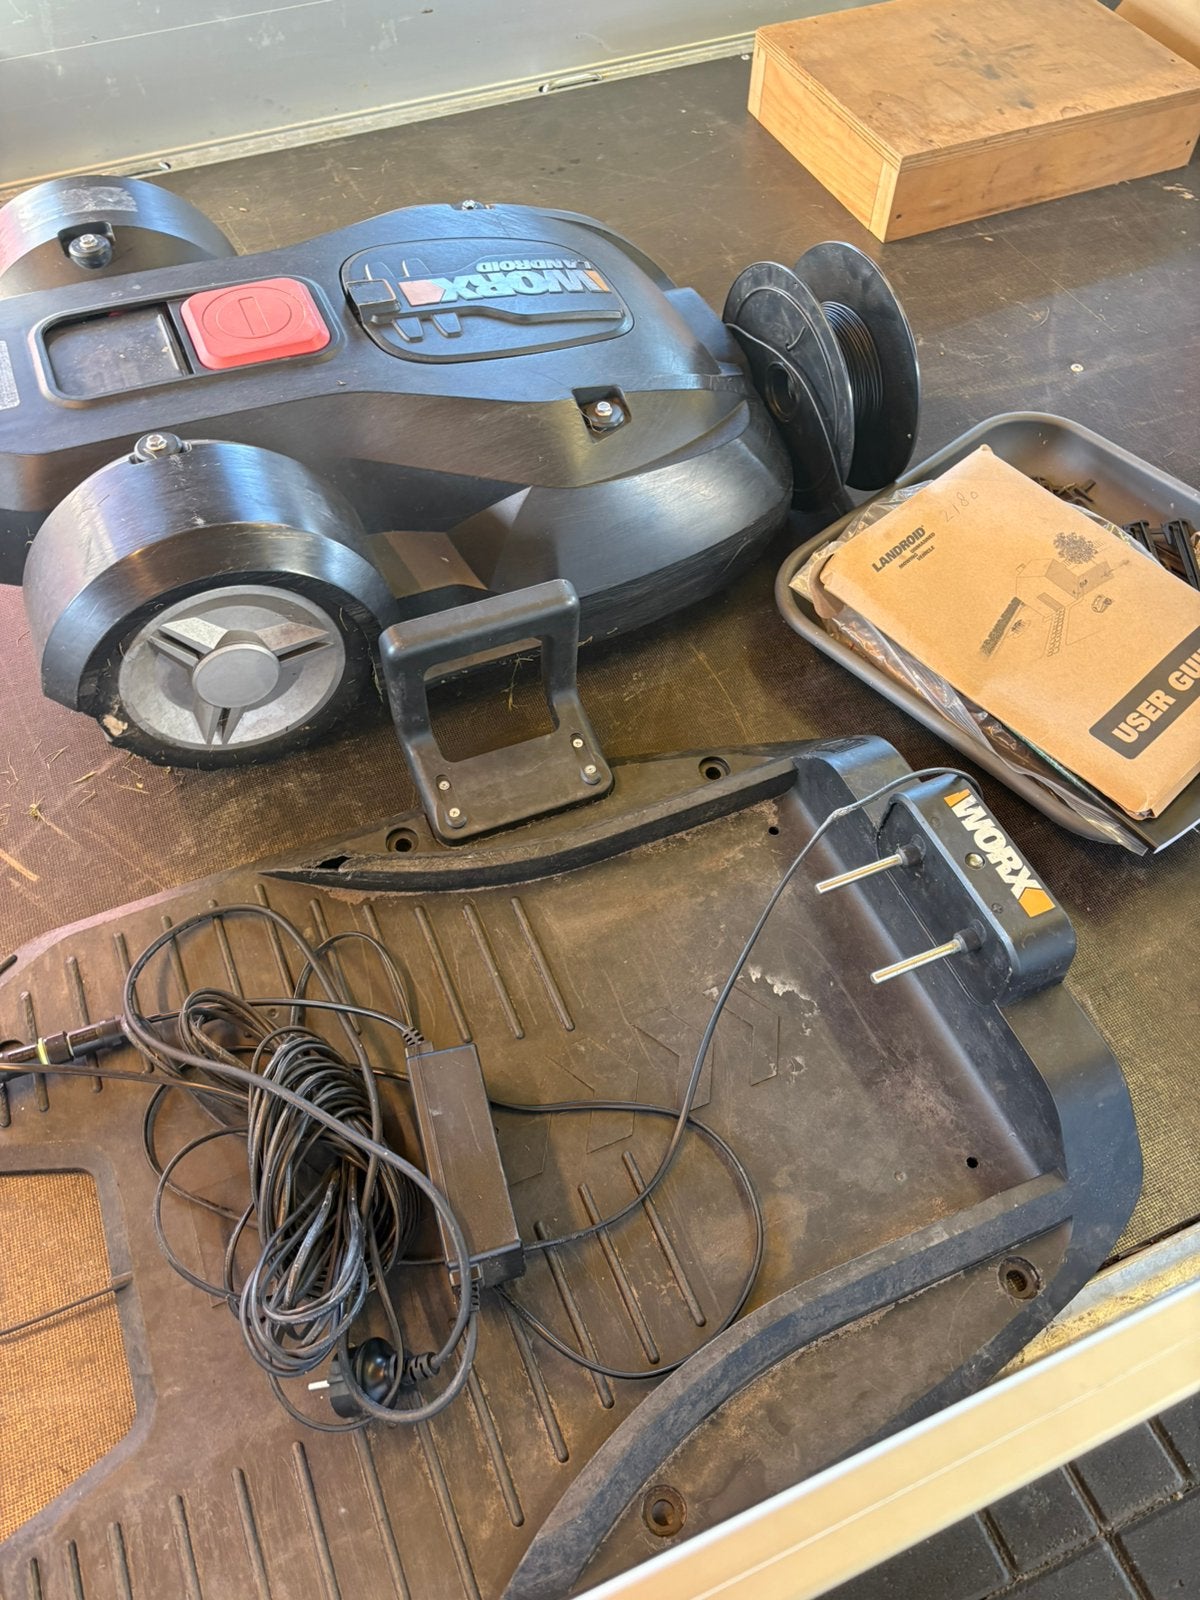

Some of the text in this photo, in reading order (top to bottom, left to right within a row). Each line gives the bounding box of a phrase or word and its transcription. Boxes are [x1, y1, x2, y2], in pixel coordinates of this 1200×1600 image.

[426, 270, 612, 304] WORX
[475, 258, 592, 274] LANDROID
[872, 526, 926, 573] LANDROID
[1111, 648, 1200, 743] USER GU
[944, 789, 1043, 900] WORX
